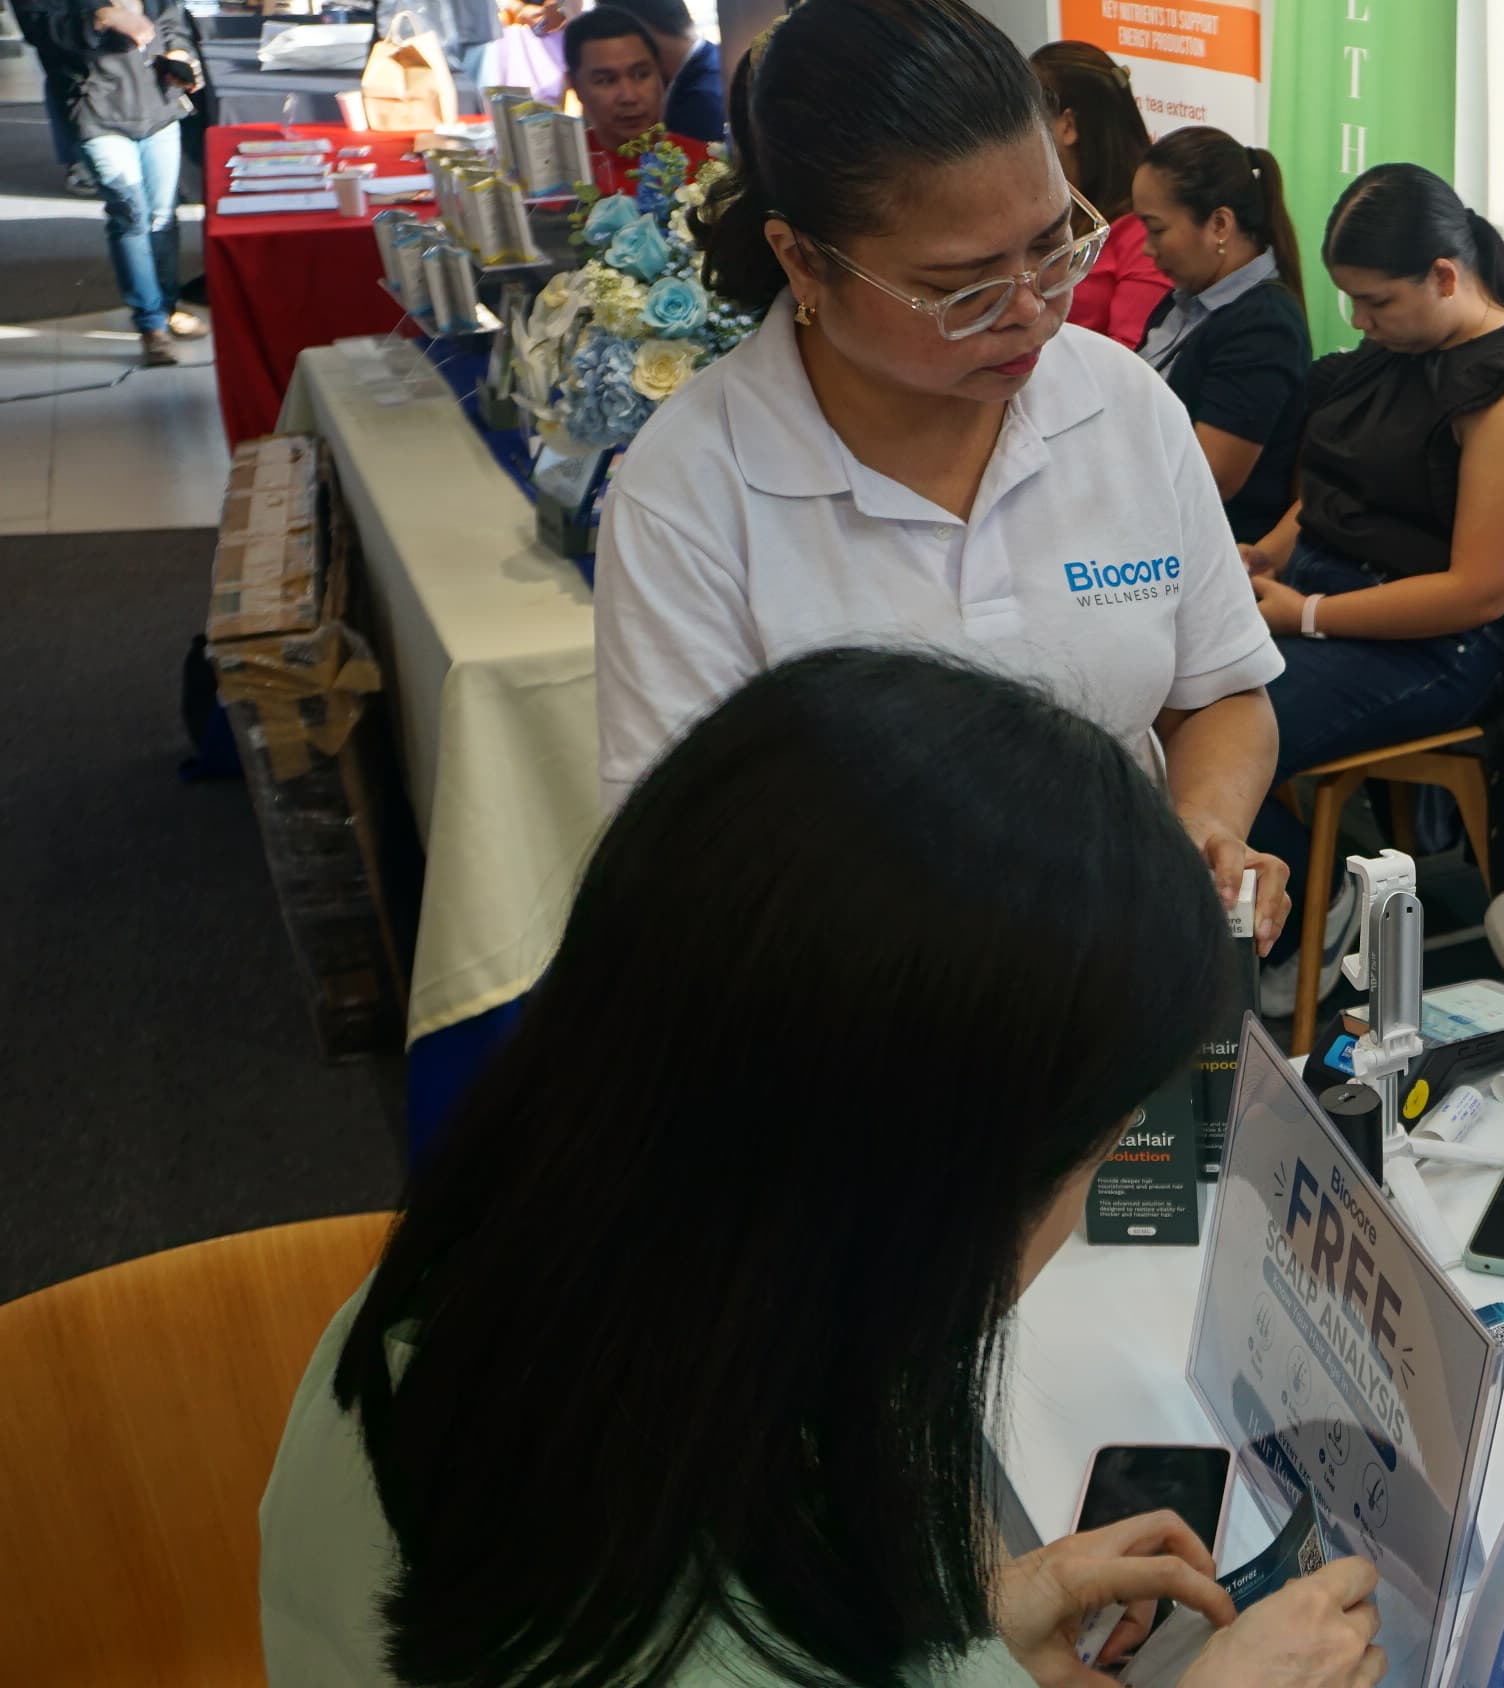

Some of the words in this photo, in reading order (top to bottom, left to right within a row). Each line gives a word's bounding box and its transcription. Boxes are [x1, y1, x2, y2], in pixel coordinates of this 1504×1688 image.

[1120, 2, 1165, 28] NUTRIENTS
[1166, 8, 1178, 28] TO
[1179, 11, 1219, 36] SUPPORT
[1118, 26, 1149, 49] ENERGY
[1152, 32, 1206, 58] PRODUCTION
[1145, 96, 1164, 113] tea
[1167, 101, 1207, 122] extract
[1063, 555, 1181, 593] Biocore
[1076, 586, 1159, 608] WELLNESS
[1165, 583, 1180, 597] PH
[1201, 1040, 1239, 1055] Hair
[1117, 1131, 1175, 1148] taHair
[1120, 1178, 1141, 1186] deeper
[1330, 1165, 1378, 1247] Biocore
[1285, 1155, 1403, 1381] FREE
[1265, 1218, 1320, 1307] SCALP
[1318, 1303, 1407, 1444] ANALYSIS
